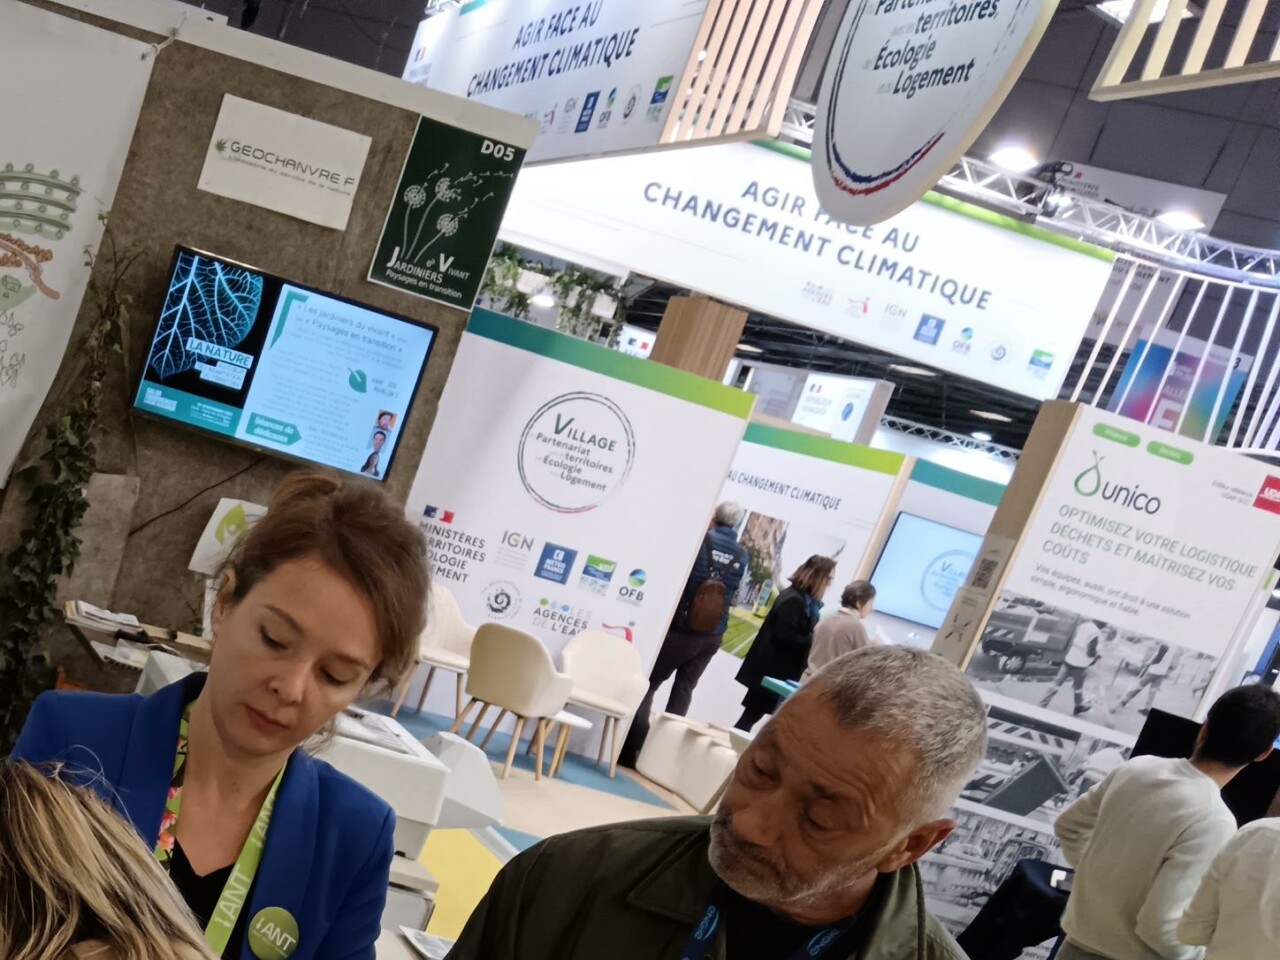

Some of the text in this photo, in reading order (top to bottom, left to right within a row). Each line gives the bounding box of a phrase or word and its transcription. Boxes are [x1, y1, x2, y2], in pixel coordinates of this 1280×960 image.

[513, 1, 604, 50] AGIR FACE AU
[467, 27, 640, 97] CHANGEMENT CLIMATIQUE
[873, 34, 937, 72] Écologie
[892, 57, 976, 100] Logement
[230, 141, 356, 186] GEOCHANVRE F
[480, 139, 517, 163] D05
[740, 181, 805, 216] AGIR
[881, 226, 921, 254] AU
[642, 181, 993, 312] CHANGEMENT CLIMATIQUE
[386, 246, 471, 284] JARDINIERS VIVANT
[386, 268, 463, 299] Paysages en transition
[311, 318, 350, 339] Paysages
[350, 331, 361, 340] en
[362, 335, 397, 352] transition
[189, 340, 203, 353] LA
[204, 345, 251, 366] NATURE
[536, 432, 591, 456] Partenariat
[554, 413, 617, 452] VILLAGE
[565, 453, 614, 474] territoires
[560, 471, 607, 492] Logement
[727, 470, 842, 510] AU CHANGEMENT CLIMATIQUE
[1102, 481, 1161, 515] unico
[419, 521, 486, 549] MINISTÈRES
[502, 530, 535, 552] IGN
[1042, 539, 1090, 565] COÛTS
[1058, 504, 1259, 579] OPTIMISEZ VOTRE LOGISTIQUE
[1050, 520, 1236, 592] DÉCHETS ET MAÎTRISEZ VOS
[619, 586, 644, 602] OFB
[1036, 563, 1051, 575] Vos
[1107, 587, 1120, 598] ont
[1145, 601, 1160, 610] une
[1160, 605, 1191, 619] solution
[1108, 600, 1118, 609] et
[533, 607, 588, 630] AGENCES
[551, 622, 581, 636] L'EA
